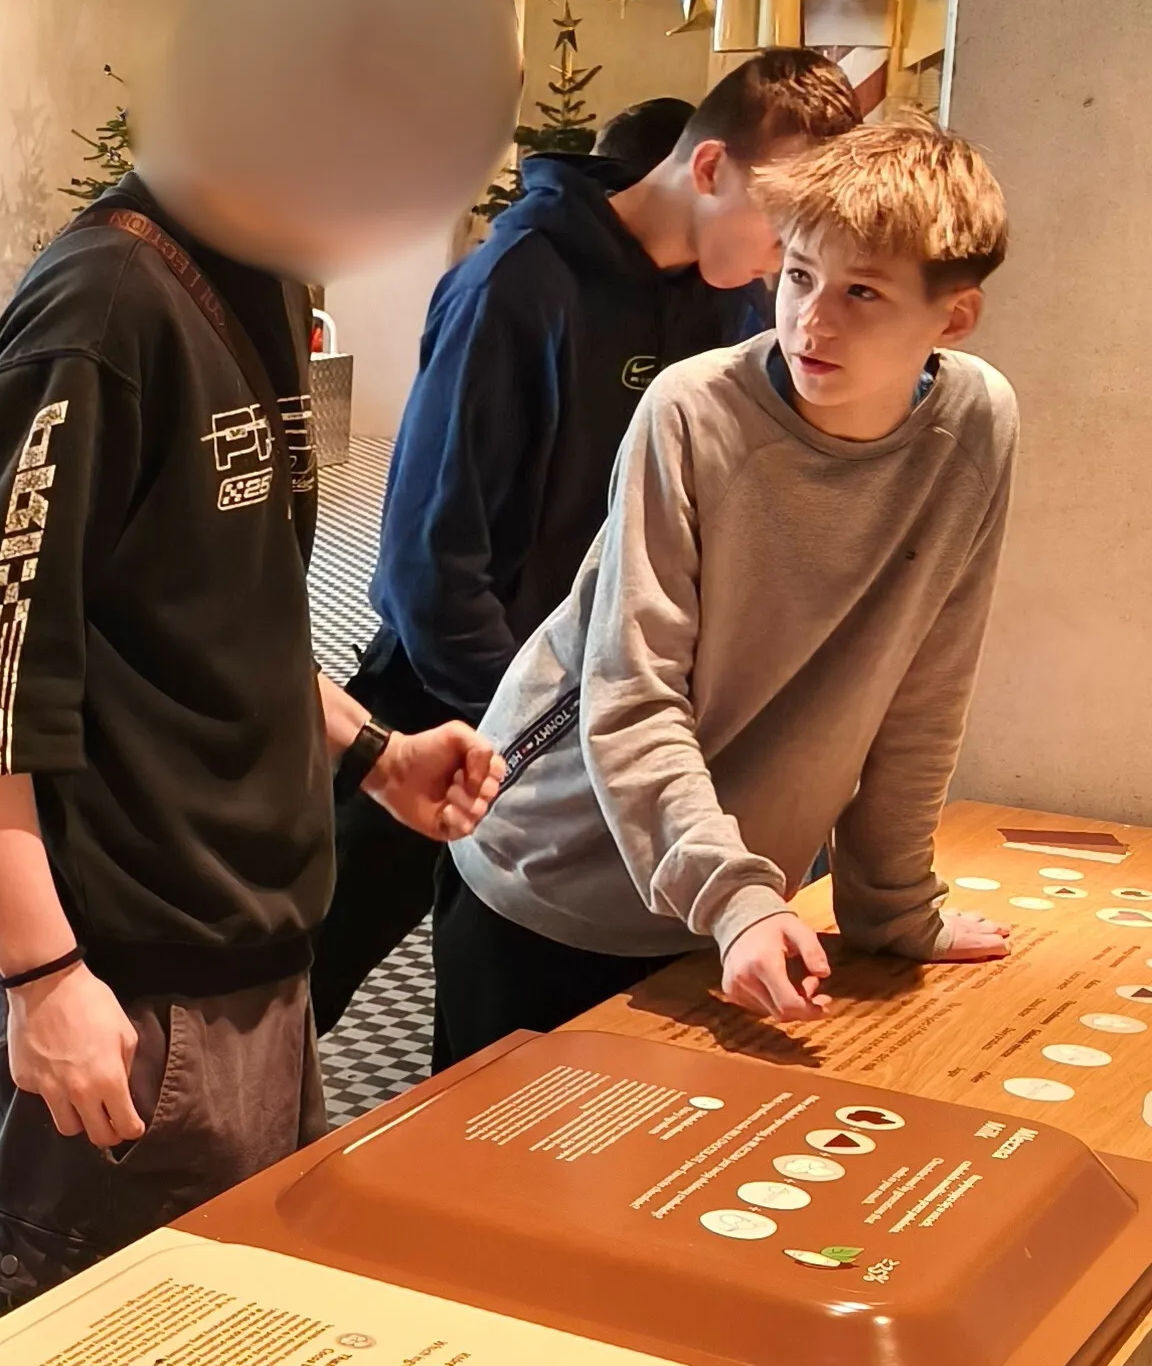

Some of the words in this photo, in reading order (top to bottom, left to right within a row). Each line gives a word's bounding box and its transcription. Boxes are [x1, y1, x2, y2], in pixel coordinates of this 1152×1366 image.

[534, 710, 571, 747] TOMMY
[974, 1120, 1006, 1139] Milk
[991, 1127, 1039, 1159] Mleczna
